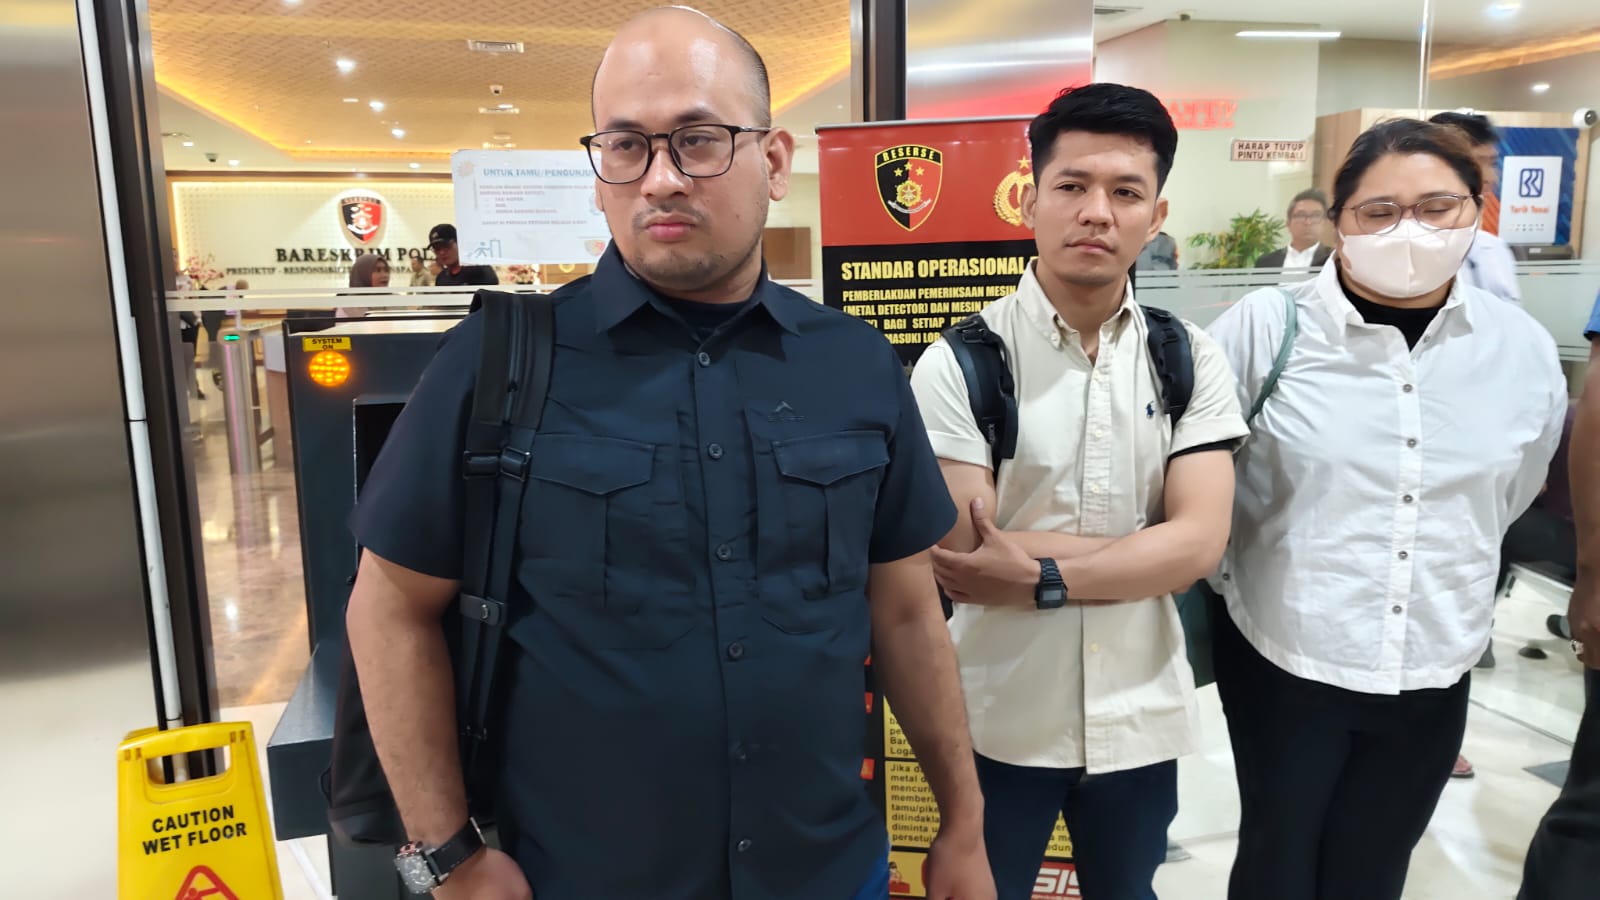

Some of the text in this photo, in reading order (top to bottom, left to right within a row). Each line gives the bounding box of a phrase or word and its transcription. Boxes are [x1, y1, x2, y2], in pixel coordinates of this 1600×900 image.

[1238, 142, 1303, 151] HARAP TUTUP
[882, 146, 935, 162] RESERSE
[1238, 151, 1264, 159] PINTU
[482, 169, 513, 177] UNTUK
[841, 256, 1025, 280] STANDAR OPERASIONAL
[843, 285, 1017, 302] PEMBERLAKUAN PEMERIKSAAN MESIN
[878, 303, 928, 315] DETECTOR)
[930, 302, 950, 313] DAN
[951, 301, 982, 312] MESIN
[884, 319, 907, 330] BAGI
[912, 317, 945, 329] SETIAP
[885, 333, 922, 344] MASUKI
[891, 764, 911, 772] Jika
[891, 775, 918, 783] metal
[891, 785, 931, 793] mencuri
[152, 805, 235, 833] CAUTION
[892, 814, 940, 823] ditindakla
[892, 823, 929, 833] diminta
[143, 822, 247, 856] WET FLOOR
